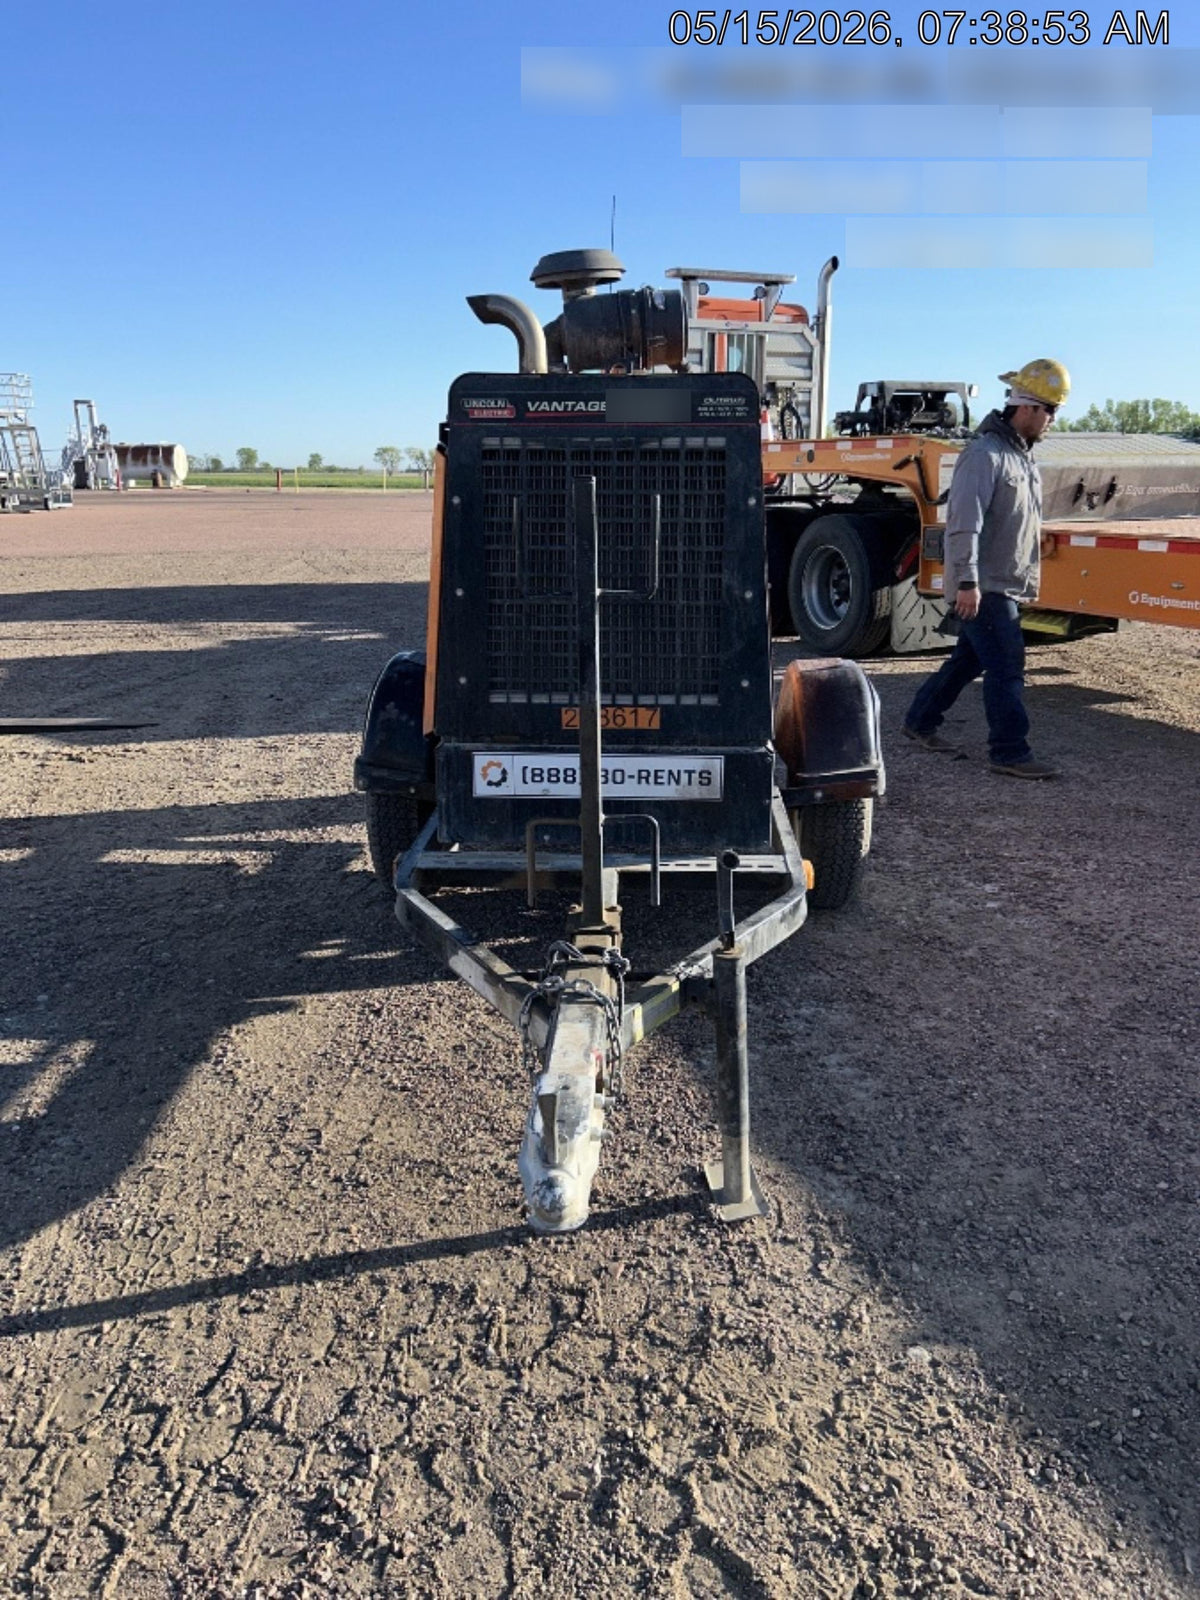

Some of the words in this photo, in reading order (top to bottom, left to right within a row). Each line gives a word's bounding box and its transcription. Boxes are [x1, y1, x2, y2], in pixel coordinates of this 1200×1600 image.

[463, 399, 506, 408] LINCOLN
[526, 400, 607, 412] VANTAGE
[564, 707, 659, 728] 2617
[521, 765, 583, 785] (888
